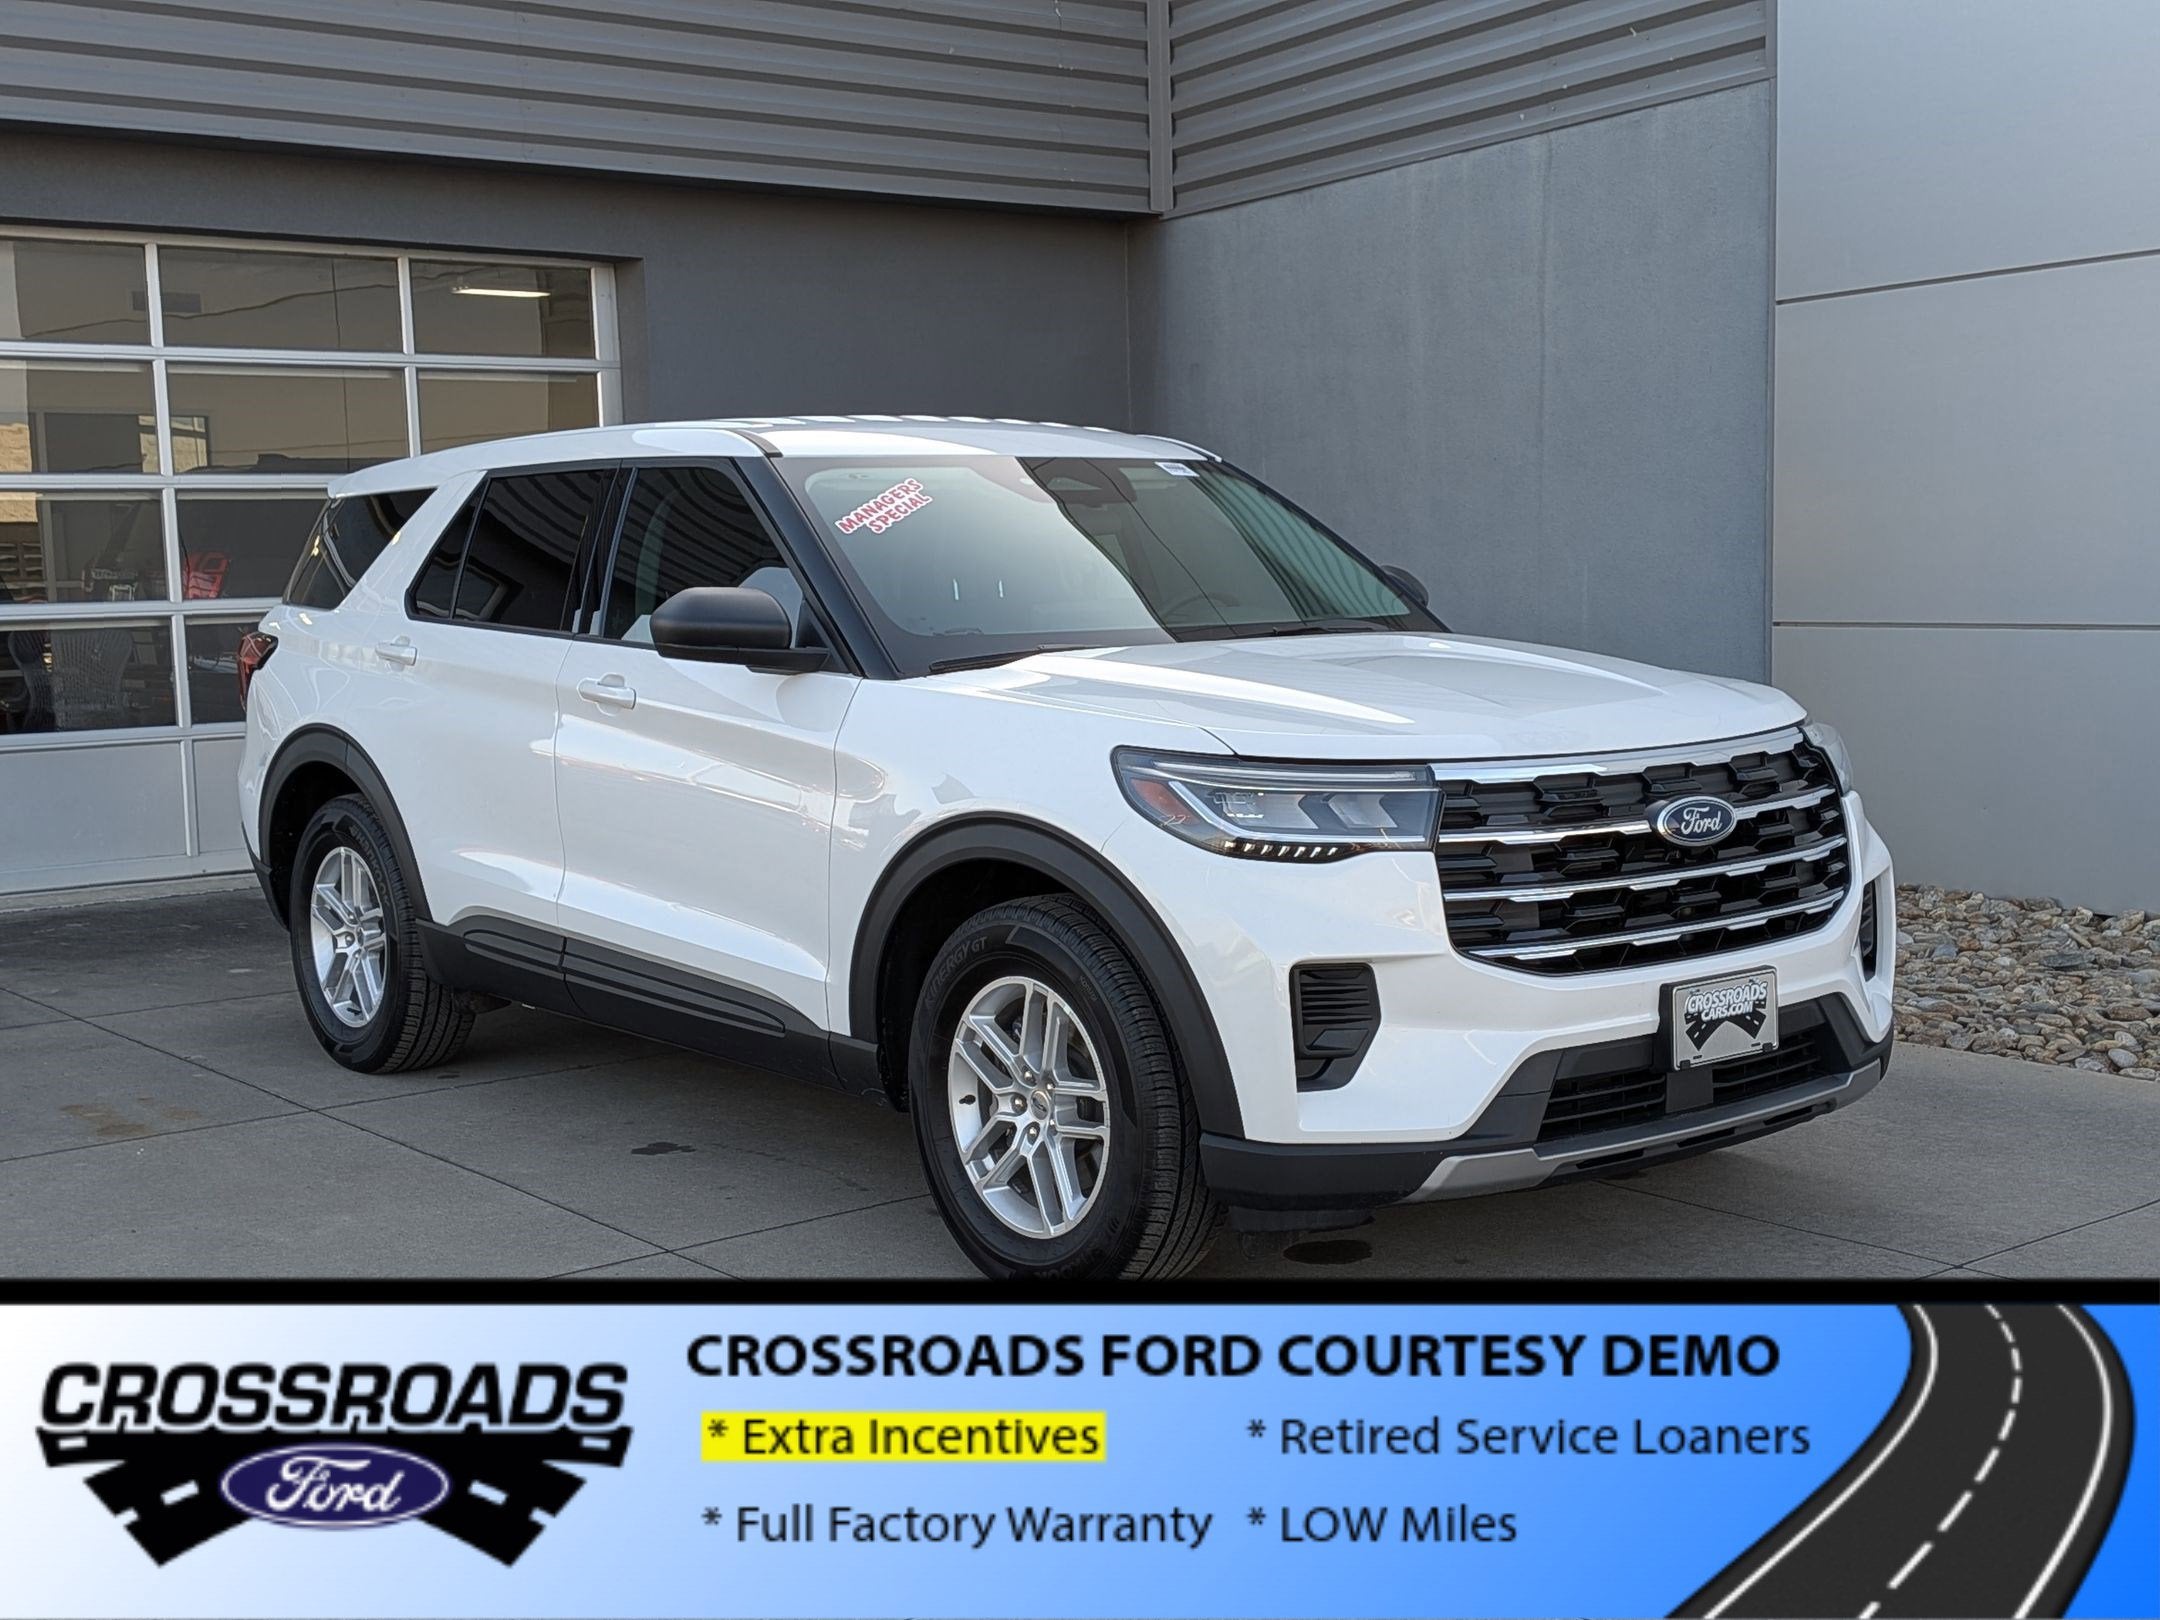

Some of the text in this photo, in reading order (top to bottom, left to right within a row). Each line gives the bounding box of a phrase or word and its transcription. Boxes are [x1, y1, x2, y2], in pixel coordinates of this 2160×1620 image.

[837, 478, 923, 532] MANAGERS
[868, 493, 931, 533] SPECIAL
[1680, 806, 1722, 835] Ford
[1687, 981, 1768, 1014] CROSSROADS
[1700, 1000, 1755, 1022] CARS.COM
